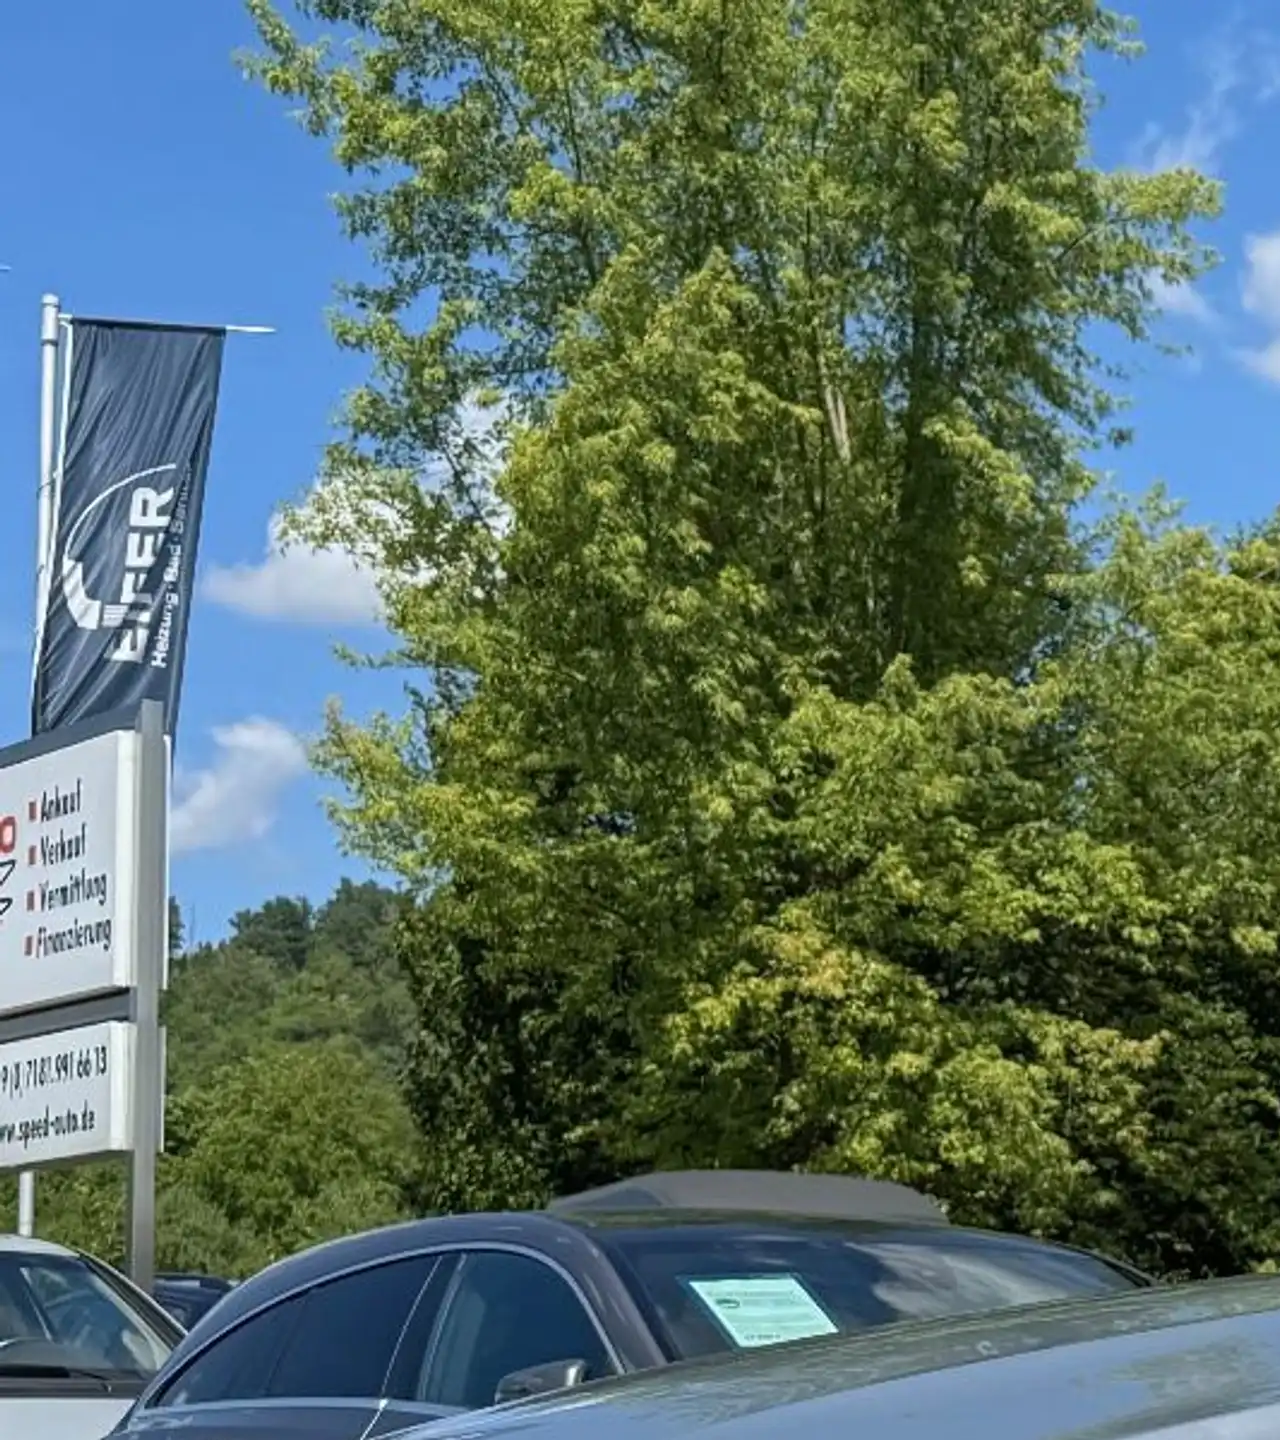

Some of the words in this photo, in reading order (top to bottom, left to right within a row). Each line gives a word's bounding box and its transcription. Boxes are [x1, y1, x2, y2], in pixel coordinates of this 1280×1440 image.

[164, 544, 181, 582] Bad
[41, 777, 82, 822] Ankauf
[41, 822, 86, 865] Verkauf
[39, 867, 107, 911] Vermittlung
[35, 918, 111, 958] Finanzierung
